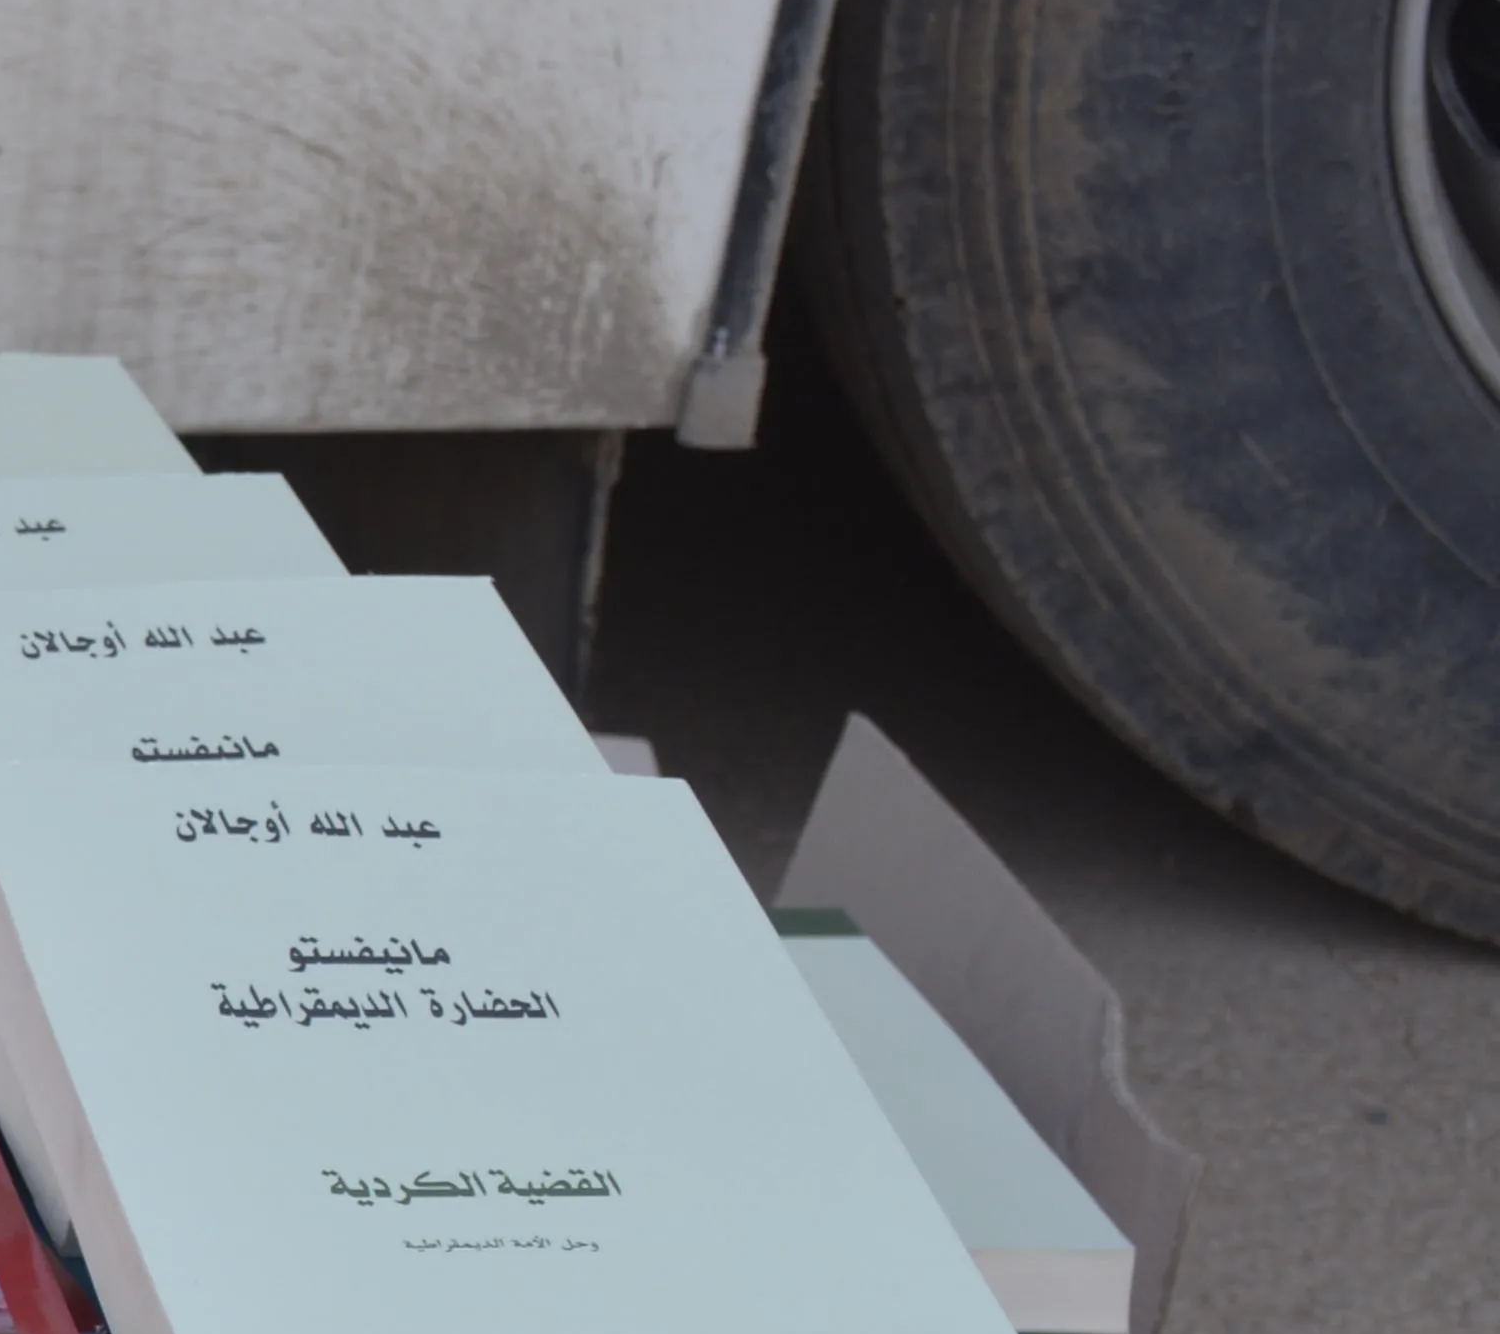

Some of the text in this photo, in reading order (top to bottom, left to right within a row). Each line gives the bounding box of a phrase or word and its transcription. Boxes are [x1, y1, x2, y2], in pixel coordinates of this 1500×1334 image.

[14, 518, 67, 543] عبد
[19, 619, 267, 661] عبد الله أوجالان
[130, 736, 281, 765] مانيفستو
[173, 801, 443, 845] عبد الله أوجالان
[287, 937, 452, 977] مانيفستو
[210, 985, 561, 1029] الحضارة الديمقراطية
[321, 1165, 623, 1206] القضية الكردية
[402, 1234, 601, 1256] وحل الأمة الديمقراطية
